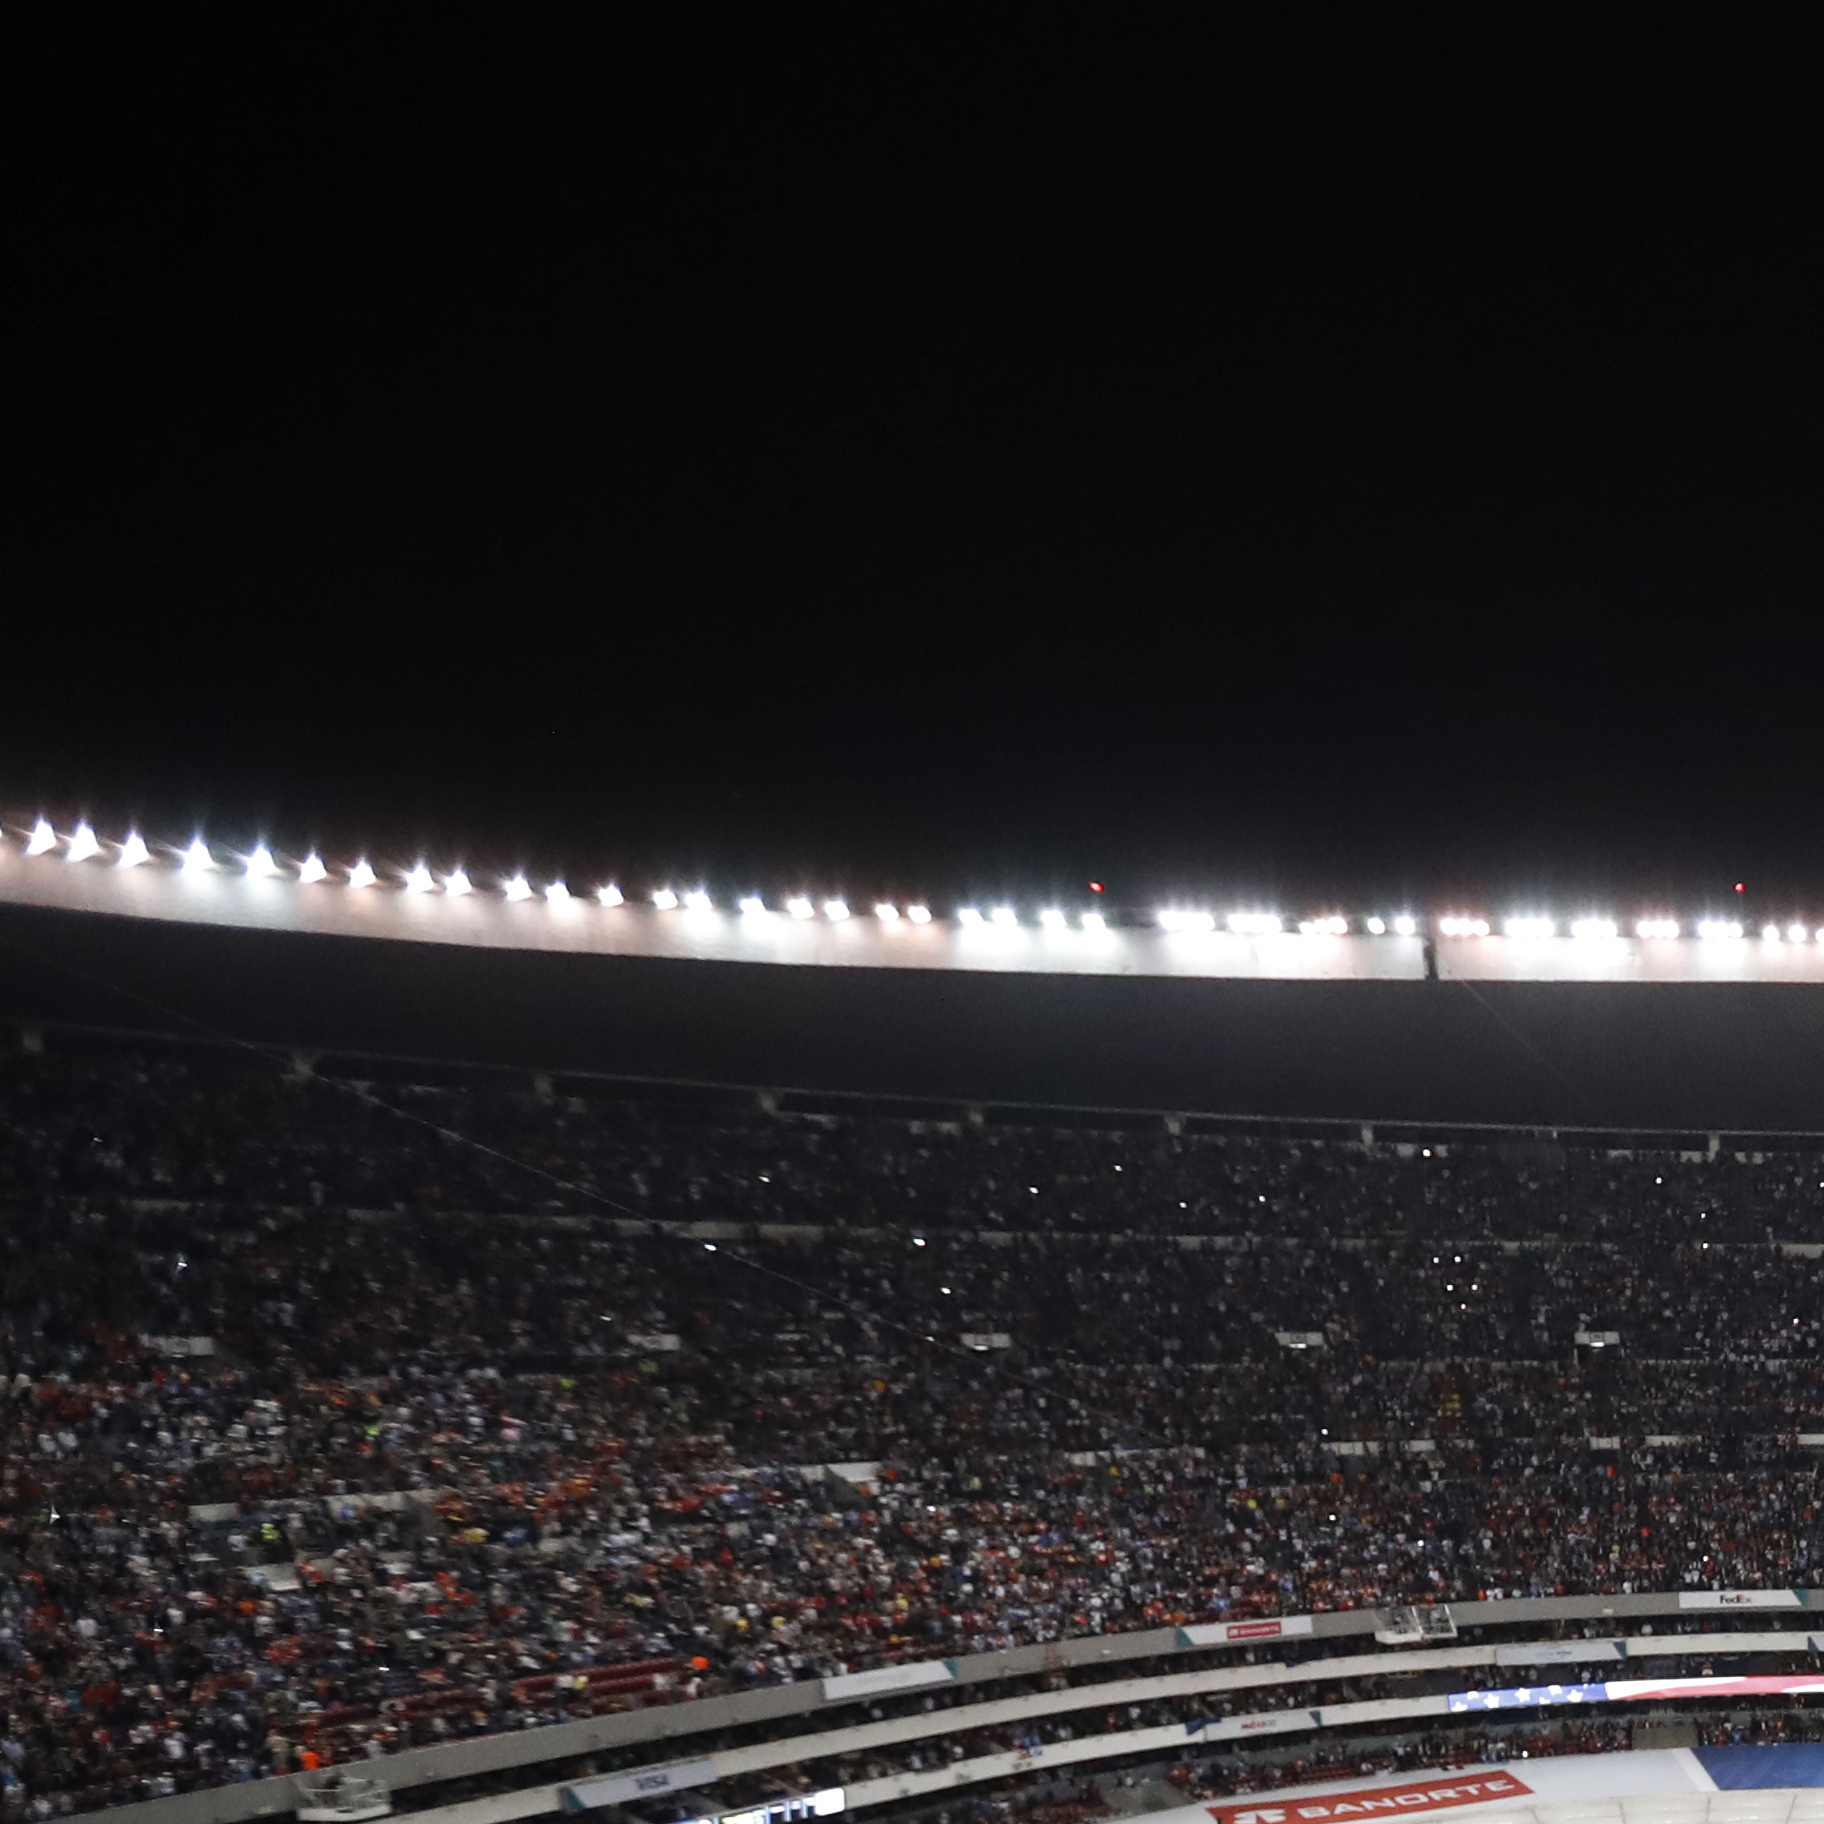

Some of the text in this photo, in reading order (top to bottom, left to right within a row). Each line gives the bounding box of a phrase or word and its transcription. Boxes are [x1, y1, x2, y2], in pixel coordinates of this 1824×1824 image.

[1719, 1594, 1752, 1604] FedEx
[635, 1773, 669, 1791] VISA
[1296, 1779, 1517, 1821] BANORTE
